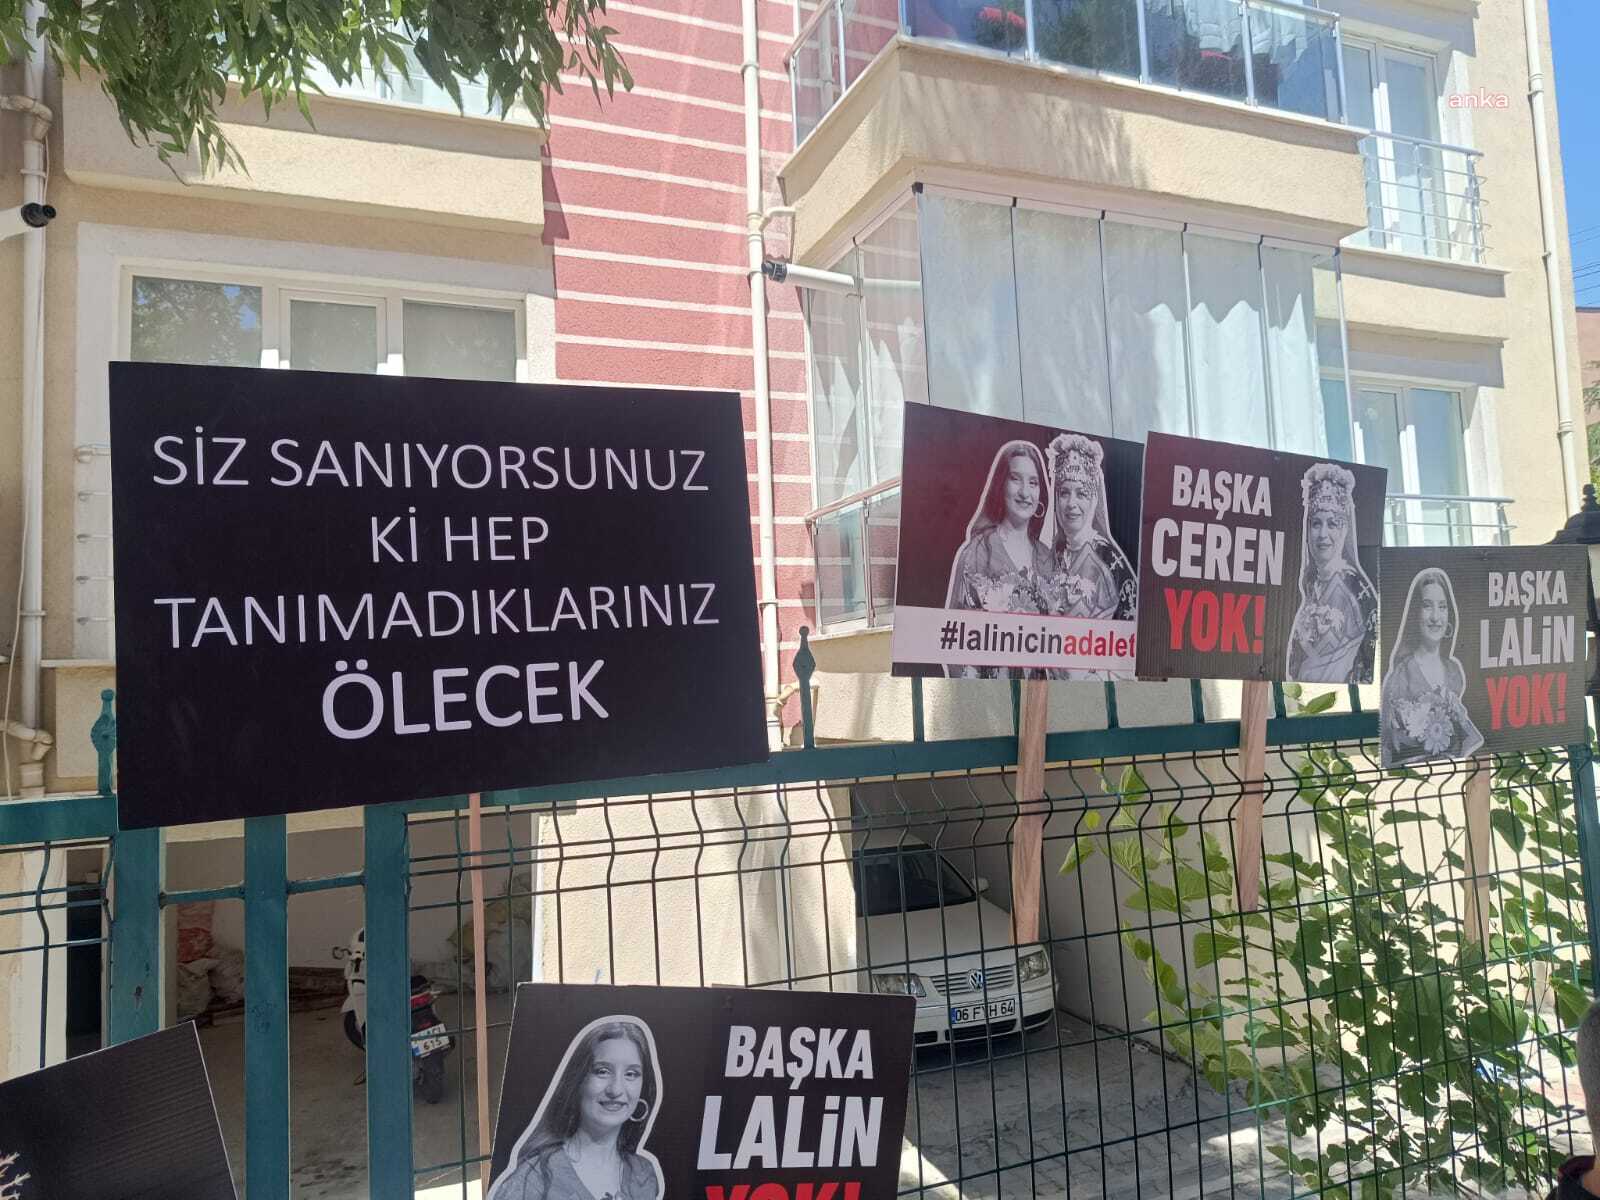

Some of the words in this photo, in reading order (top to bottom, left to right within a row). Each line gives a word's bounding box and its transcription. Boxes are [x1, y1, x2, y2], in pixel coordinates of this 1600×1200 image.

[153, 425, 249, 486] SİZ
[270, 438, 709, 491] SANIYORSUNUZ
[1172, 464, 1272, 521] BAŞKA
[371, 506, 418, 563] Kİ
[444, 516, 549, 562] HEP
[1151, 517, 1285, 586] CEREN
[153, 582, 720, 649] TANIMADIKLARINIZ
[1163, 587, 1266, 655] YOK!
[1488, 570, 1569, 614] BAŞKA
[940, 620, 1136, 658] #lalinicinadalet
[322, 658, 609, 740] ÖLECEK
[1486, 671, 1567, 731] YOK!
[956, 1008, 969, 1021] 06
[1001, 1001, 1013, 1015] 64
[724, 1025, 874, 1090] BAŞKA
